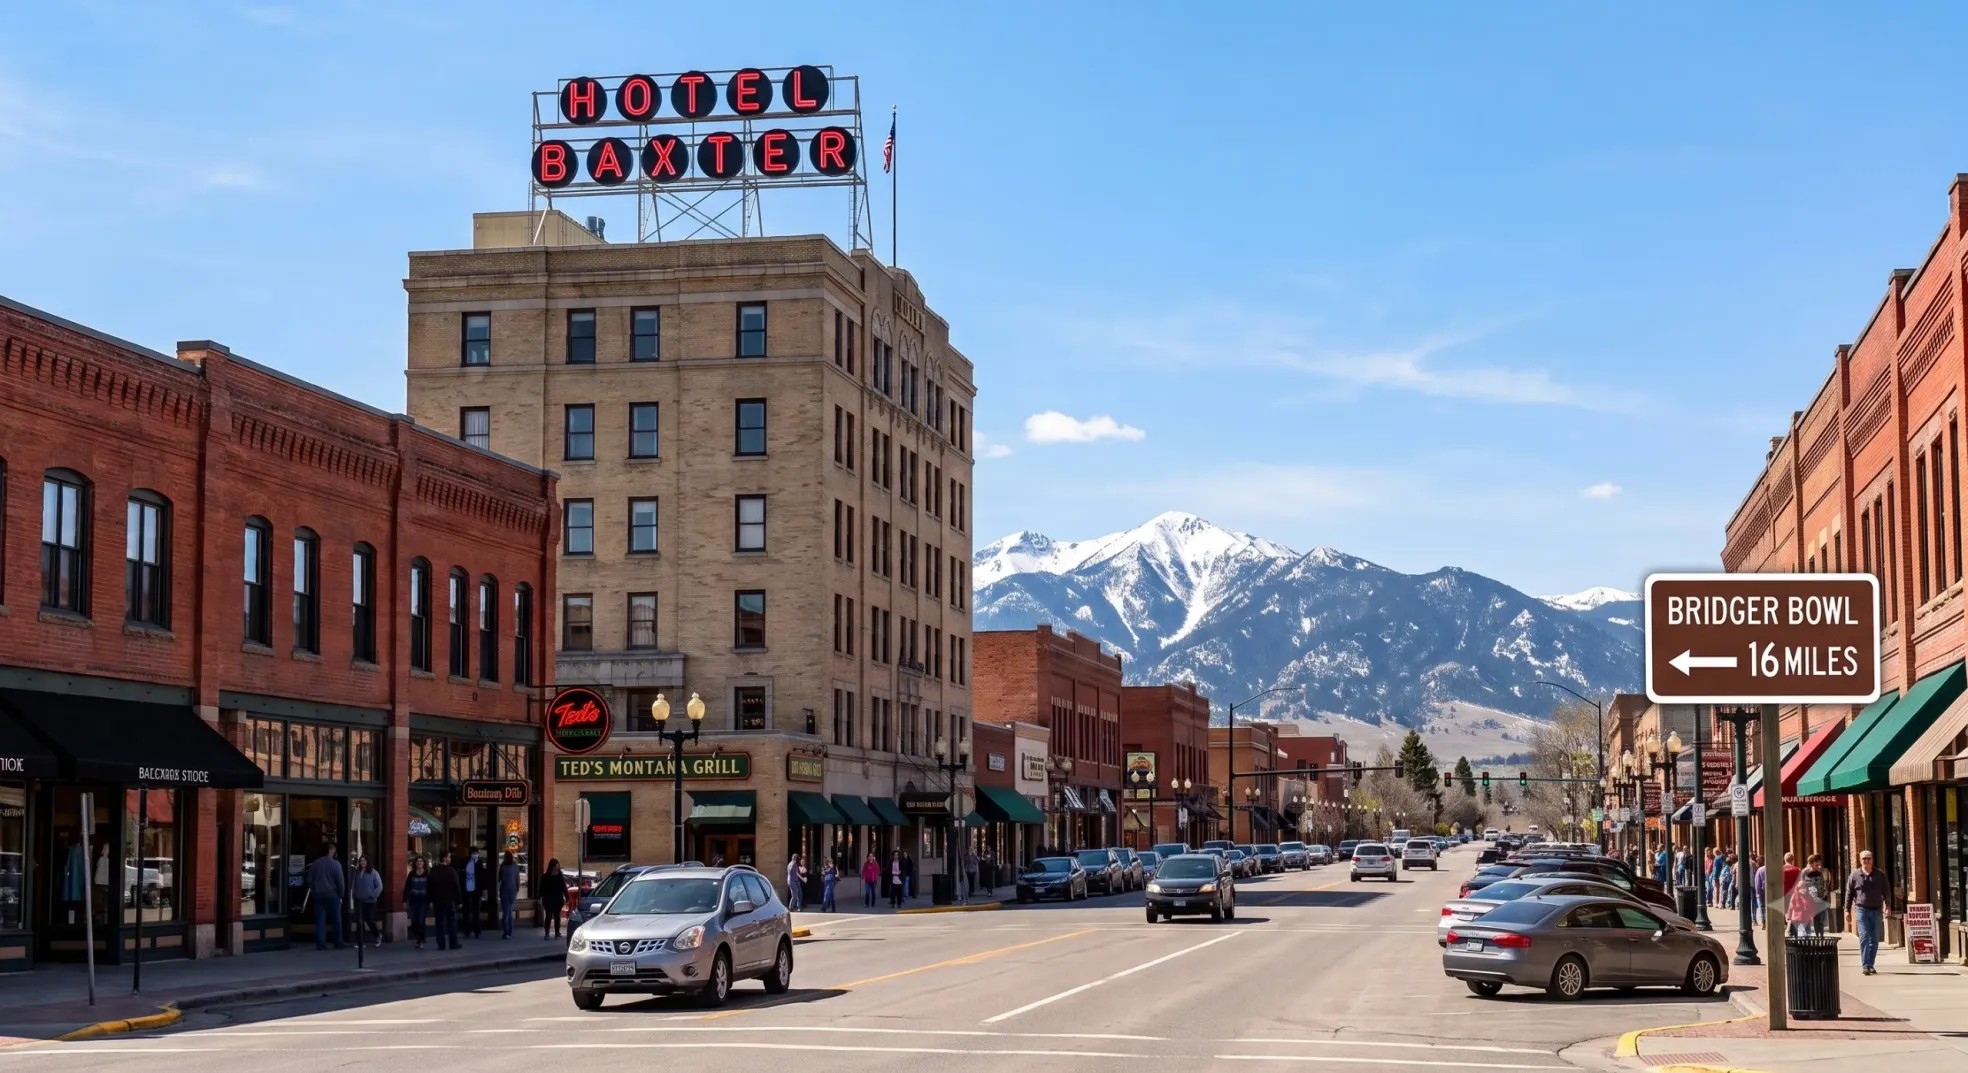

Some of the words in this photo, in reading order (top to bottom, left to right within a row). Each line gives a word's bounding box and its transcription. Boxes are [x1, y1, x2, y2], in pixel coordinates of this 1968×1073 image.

[569, 70, 816, 119] HOTEL
[541, 131, 846, 182] BAXTER
[1668, 596, 1779, 625] BRIDGER
[1788, 596, 1858, 625] BOWL
[1748, 641, 1780, 678] 16
[1784, 646, 1858, 676] MILES
[560, 761, 604, 776] TED'S
[609, 760, 688, 775] MONTANA
[693, 759, 740, 774] GRILL
